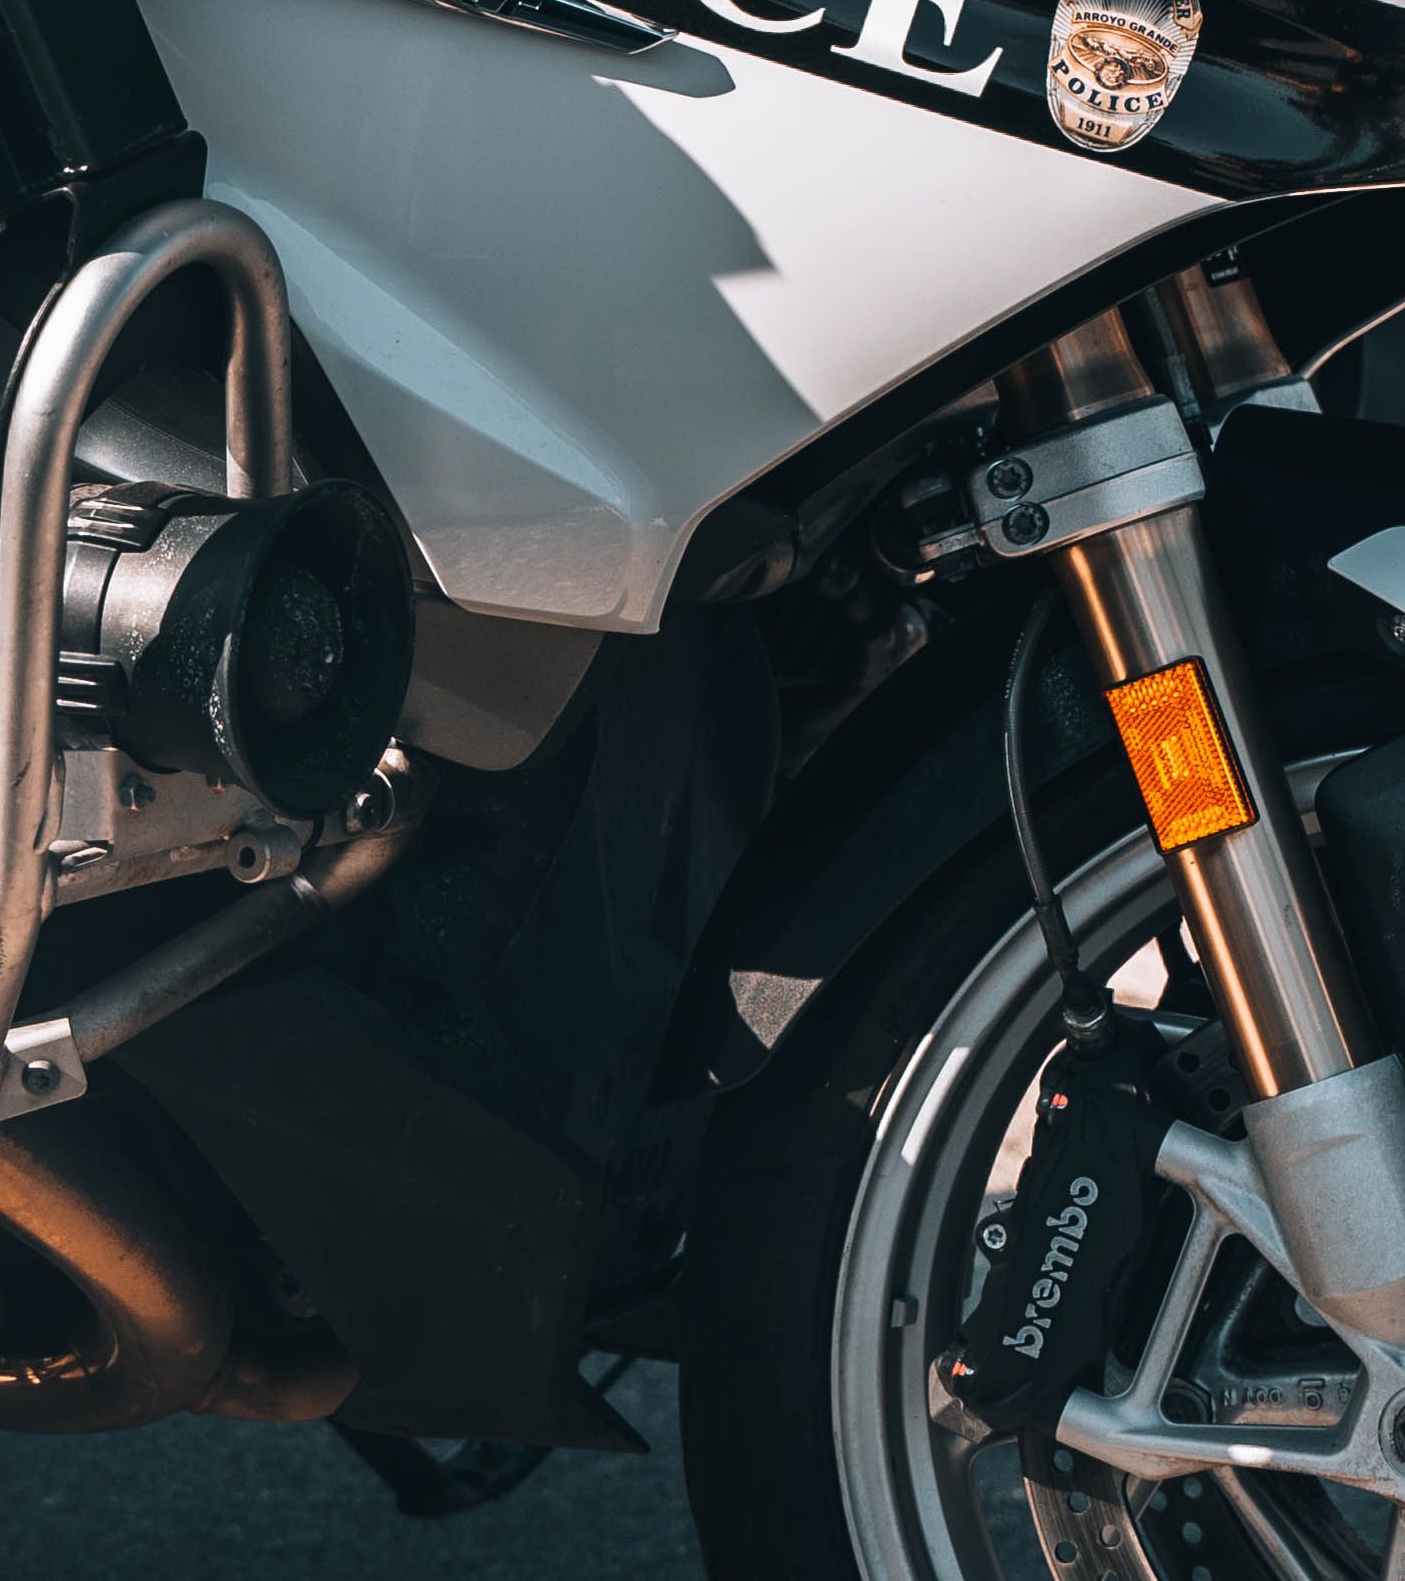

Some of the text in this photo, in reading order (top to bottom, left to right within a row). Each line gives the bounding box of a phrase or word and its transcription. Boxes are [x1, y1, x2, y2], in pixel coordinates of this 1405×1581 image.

[1074, 11, 1179, 54] ARROYO GRANDE
[1052, 59, 1165, 113] POLICE
[1077, 117, 1112, 137] 1911
[1002, 1176, 1099, 1359] brembo
